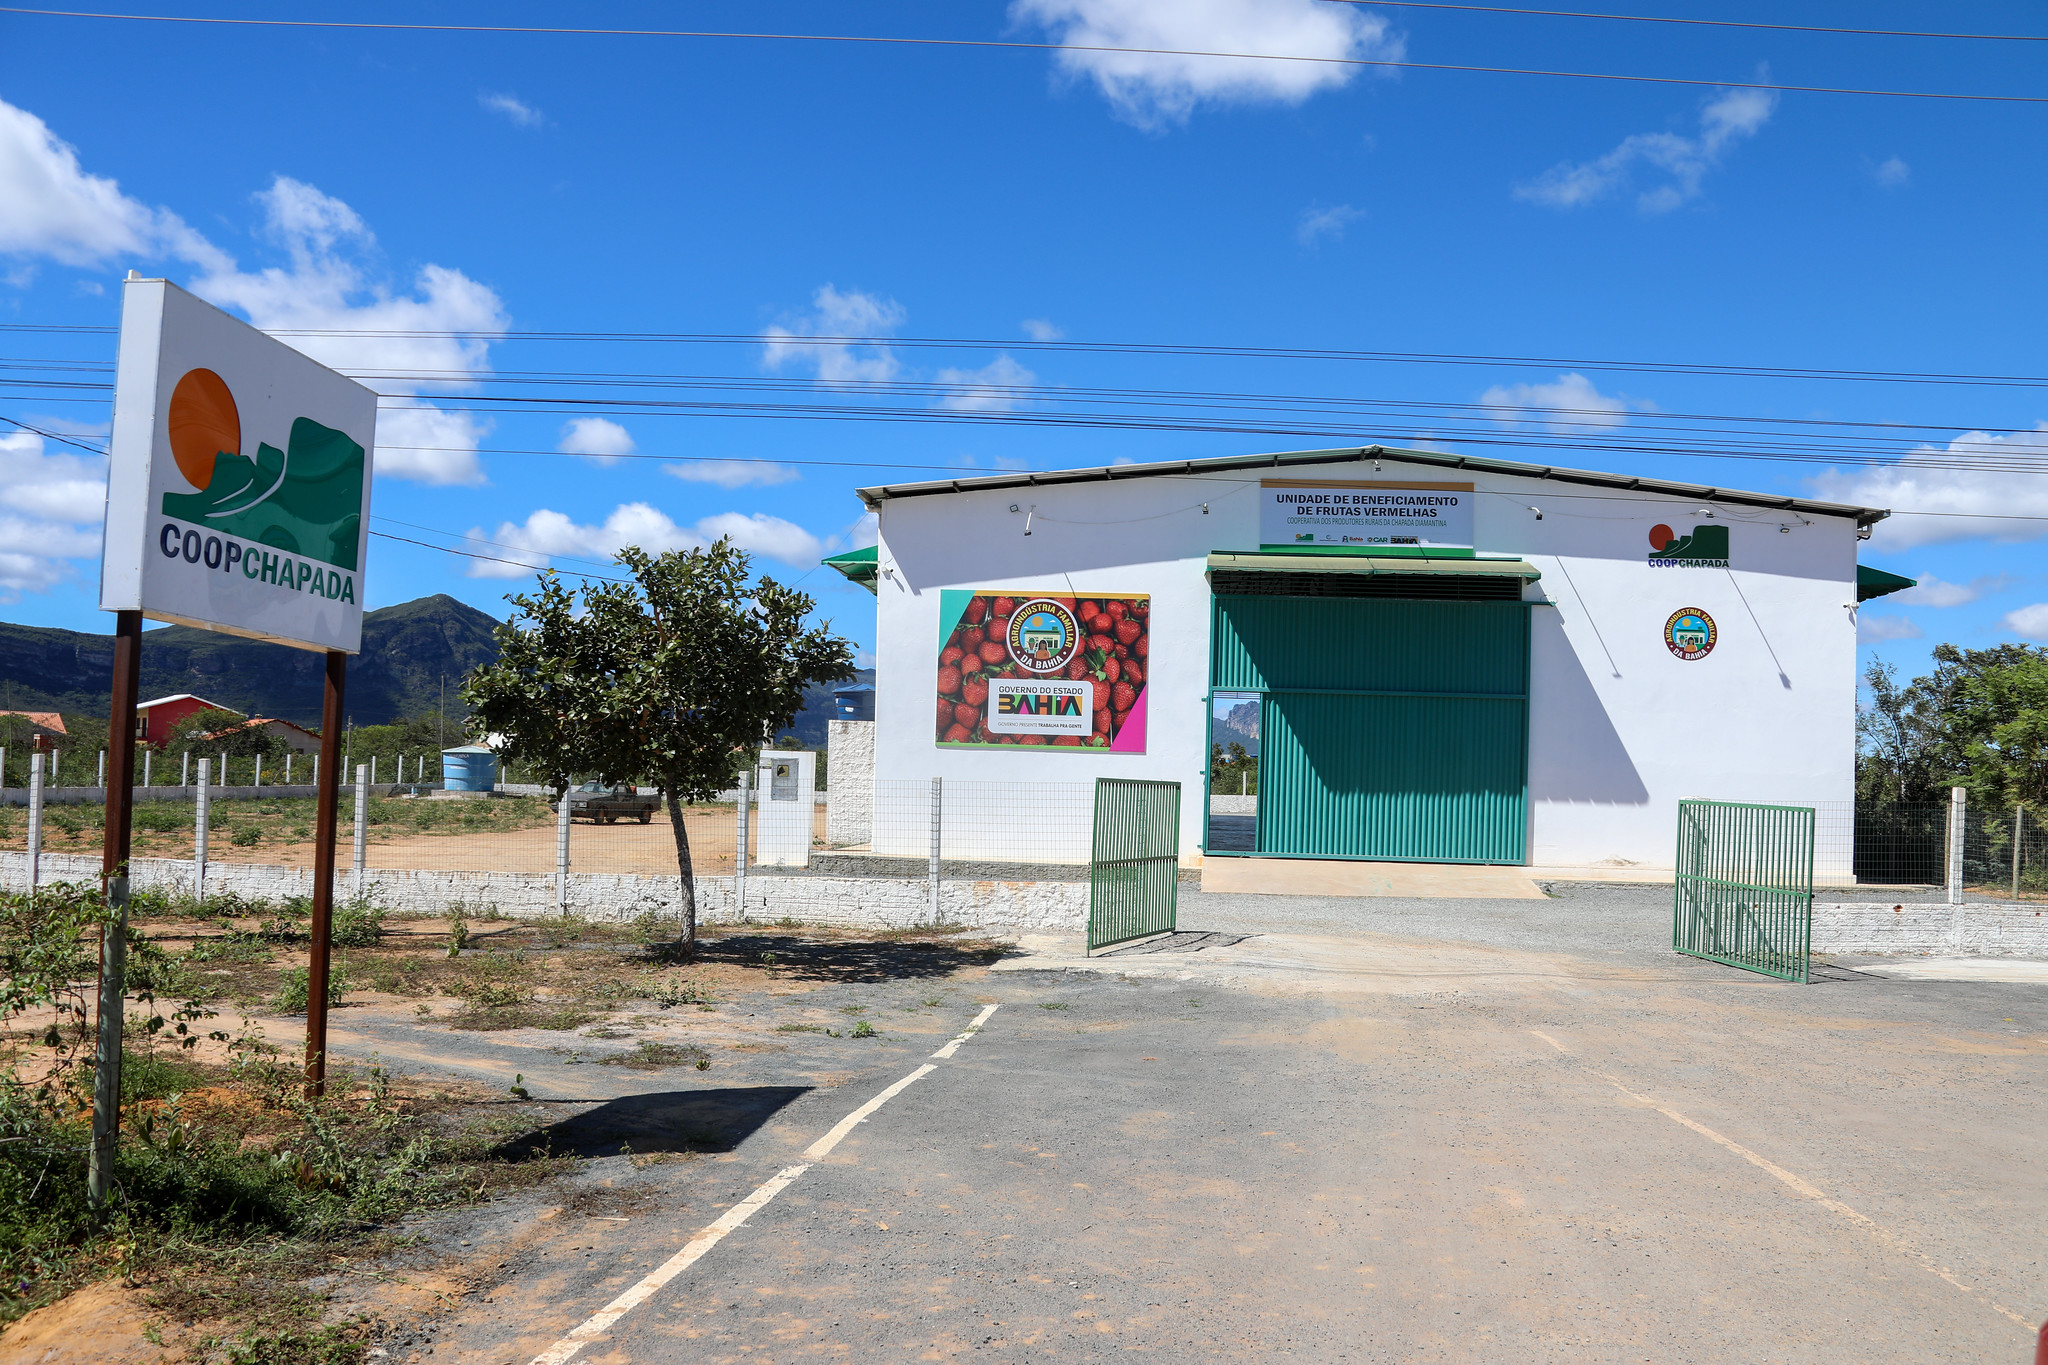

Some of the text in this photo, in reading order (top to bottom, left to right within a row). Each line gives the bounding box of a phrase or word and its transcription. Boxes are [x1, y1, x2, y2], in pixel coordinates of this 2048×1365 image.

[1276, 494, 1459, 506] UNIDADE DE BENEFICIAMENTO
[1297, 506, 1438, 518] DE FRUTAS VERMELHAS
[1286, 516, 1448, 528] COOPERATIVA DOS PRODUTORES RURAIS DA CHAPADA DIAMANTINA
[159, 523, 355, 605] COOPCHAPADA
[1648, 559, 1730, 568] COOPCHAPADA
[1011, 603, 1074, 648] AGROINDÚSTRIA FAMILIAR
[1701, 613, 1716, 644] FAMILIAR
[1673, 648, 1708, 660] DA BAHIA
[1020, 654, 1064, 669] DA BAHIA
[998, 686, 1038, 694] GOVERNO
[1053, 687, 1084, 695] ESTADO
[998, 694, 1083, 716] BAHIA
